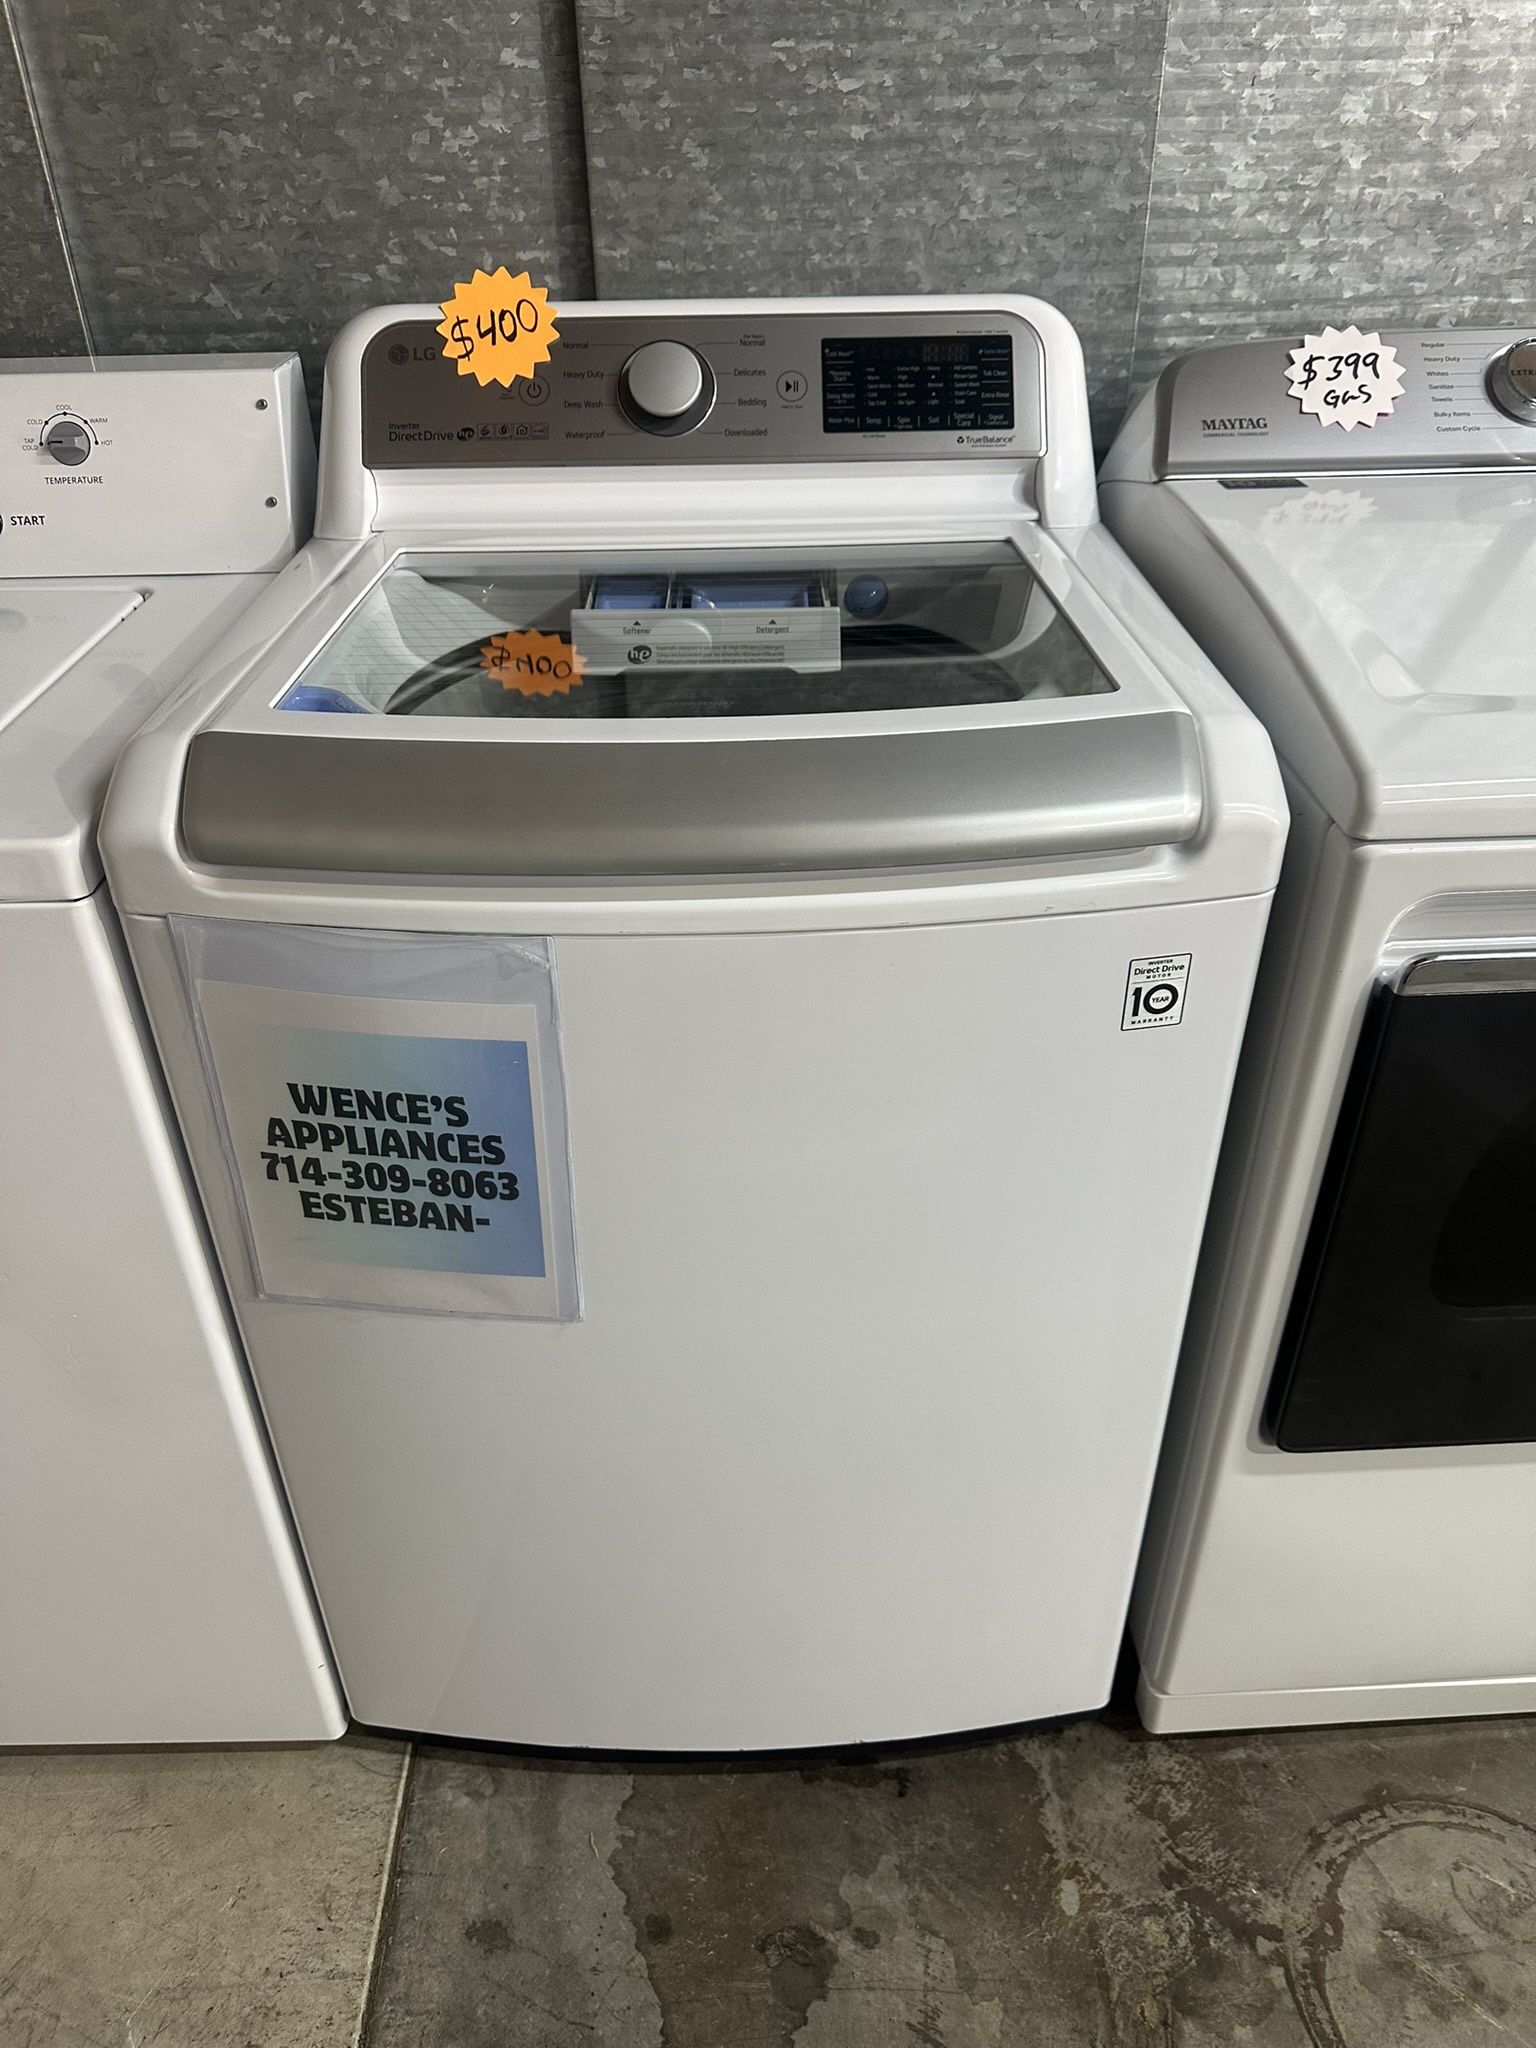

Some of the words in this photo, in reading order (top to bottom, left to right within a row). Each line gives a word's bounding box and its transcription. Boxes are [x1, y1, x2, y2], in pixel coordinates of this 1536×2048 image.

[451, 299, 538, 362] $400
[739, 339, 766, 347] Normal
[413, 347, 436, 361] LG
[563, 371, 585, 379] Heavy
[587, 370, 604, 379] Duty
[733, 368, 767, 377] Delicates
[1296, 352, 1381, 391] $399
[564, 401, 582, 409] Deep
[738, 398, 767, 408] Bedding
[388, 422, 420, 430] Inverter
[1201, 417, 1268, 432] MAYTAG
[565, 430, 605, 440] Waterproof
[725, 428, 768, 437] Downloaded
[45, 475, 103, 485] TEMPERATURE
[10, 515, 46, 526] START
[622, 627, 651, 635] Softener
[755, 626, 790, 634] Detergent
[1134, 966, 1160, 976] Direct
[1161, 964, 1185, 973] Drive
[1131, 983, 1179, 1017] 10
[1131, 1016, 1174, 1025] WARRANTY
[286, 1082, 469, 1128] WENCE'S
[266, 1117, 506, 1165] APPLIANCES
[260, 1151, 520, 1201] 714-309-8063
[298, 1190, 491, 1233] ESTEBAN-
